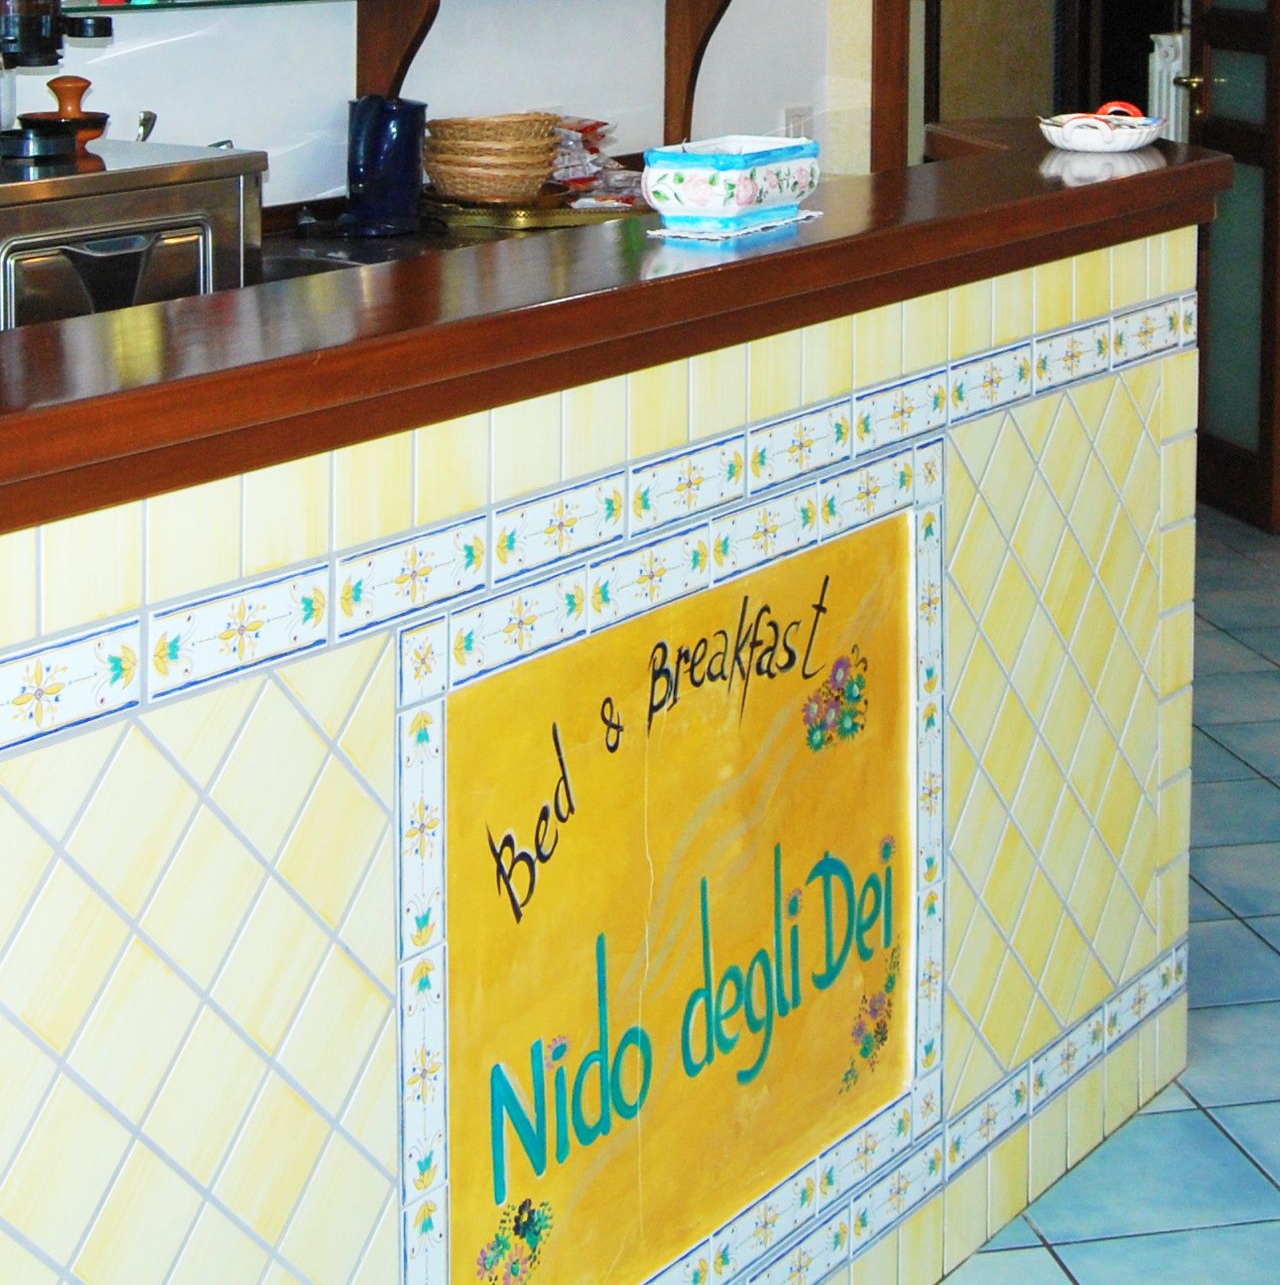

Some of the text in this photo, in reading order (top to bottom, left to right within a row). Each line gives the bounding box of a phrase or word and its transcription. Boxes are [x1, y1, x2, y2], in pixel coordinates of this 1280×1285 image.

[486, 575, 830, 924] Bed & Breakfast
[490, 837, 896, 1205] Nido degli Dei
